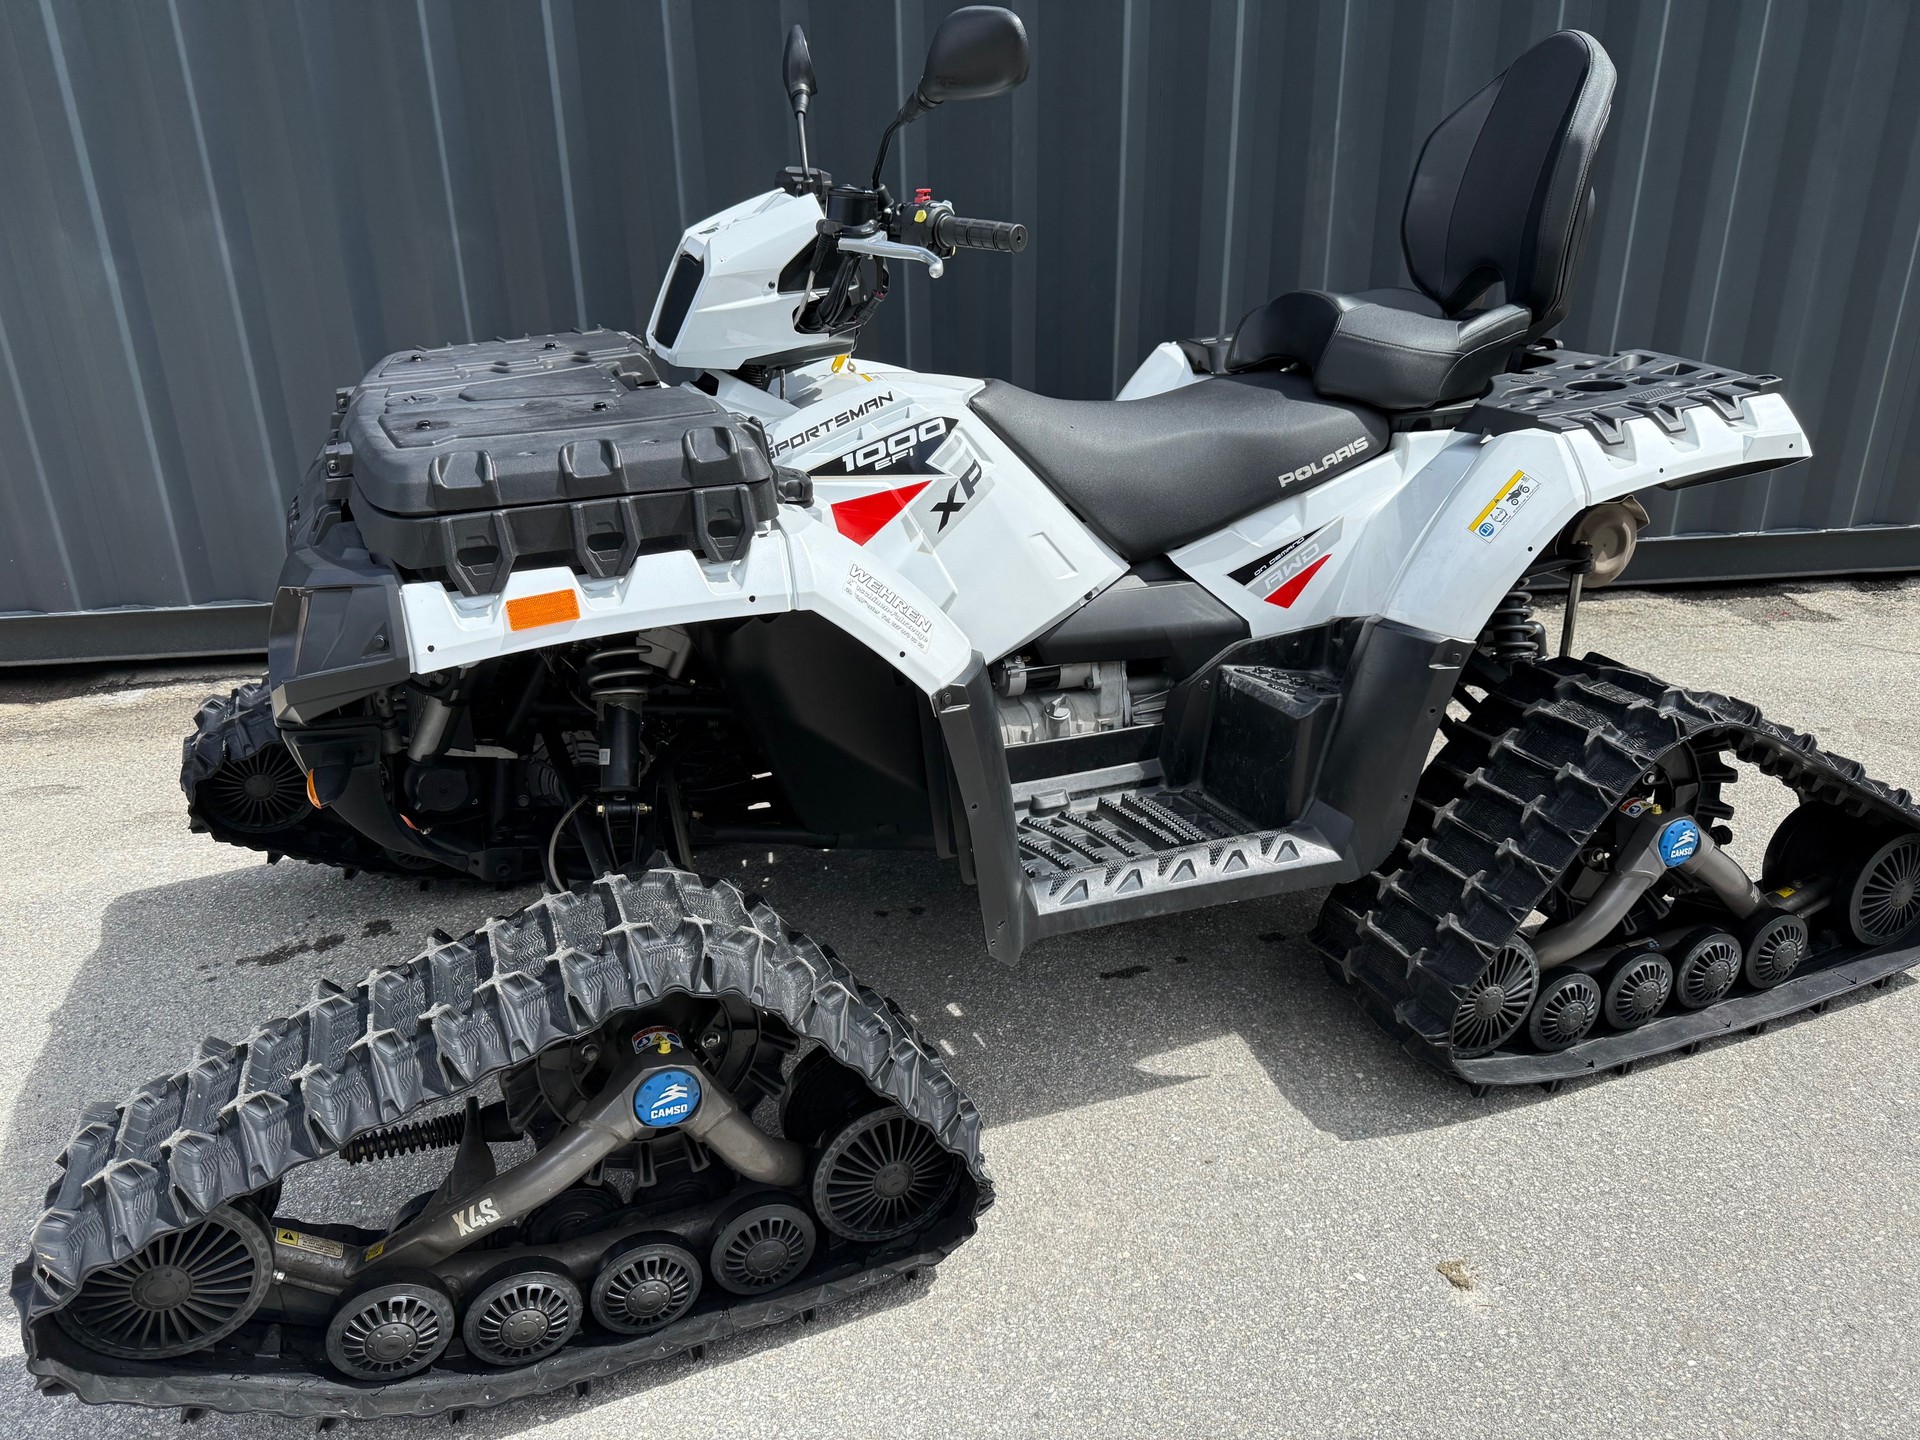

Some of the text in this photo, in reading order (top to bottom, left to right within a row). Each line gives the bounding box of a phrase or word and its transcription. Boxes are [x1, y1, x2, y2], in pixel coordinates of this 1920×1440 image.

[842, 417, 947, 473] 1000
[875, 447, 914, 471] EFI
[1277, 436, 1370, 488] POLARIS
[930, 458, 982, 534] XP
[1264, 543, 1320, 591] AWD
[849, 563, 933, 634] WEHREN
[1670, 847, 1693, 858] CAMSO
[650, 1104, 688, 1119] CAMSO
[452, 1197, 501, 1237] X4S
